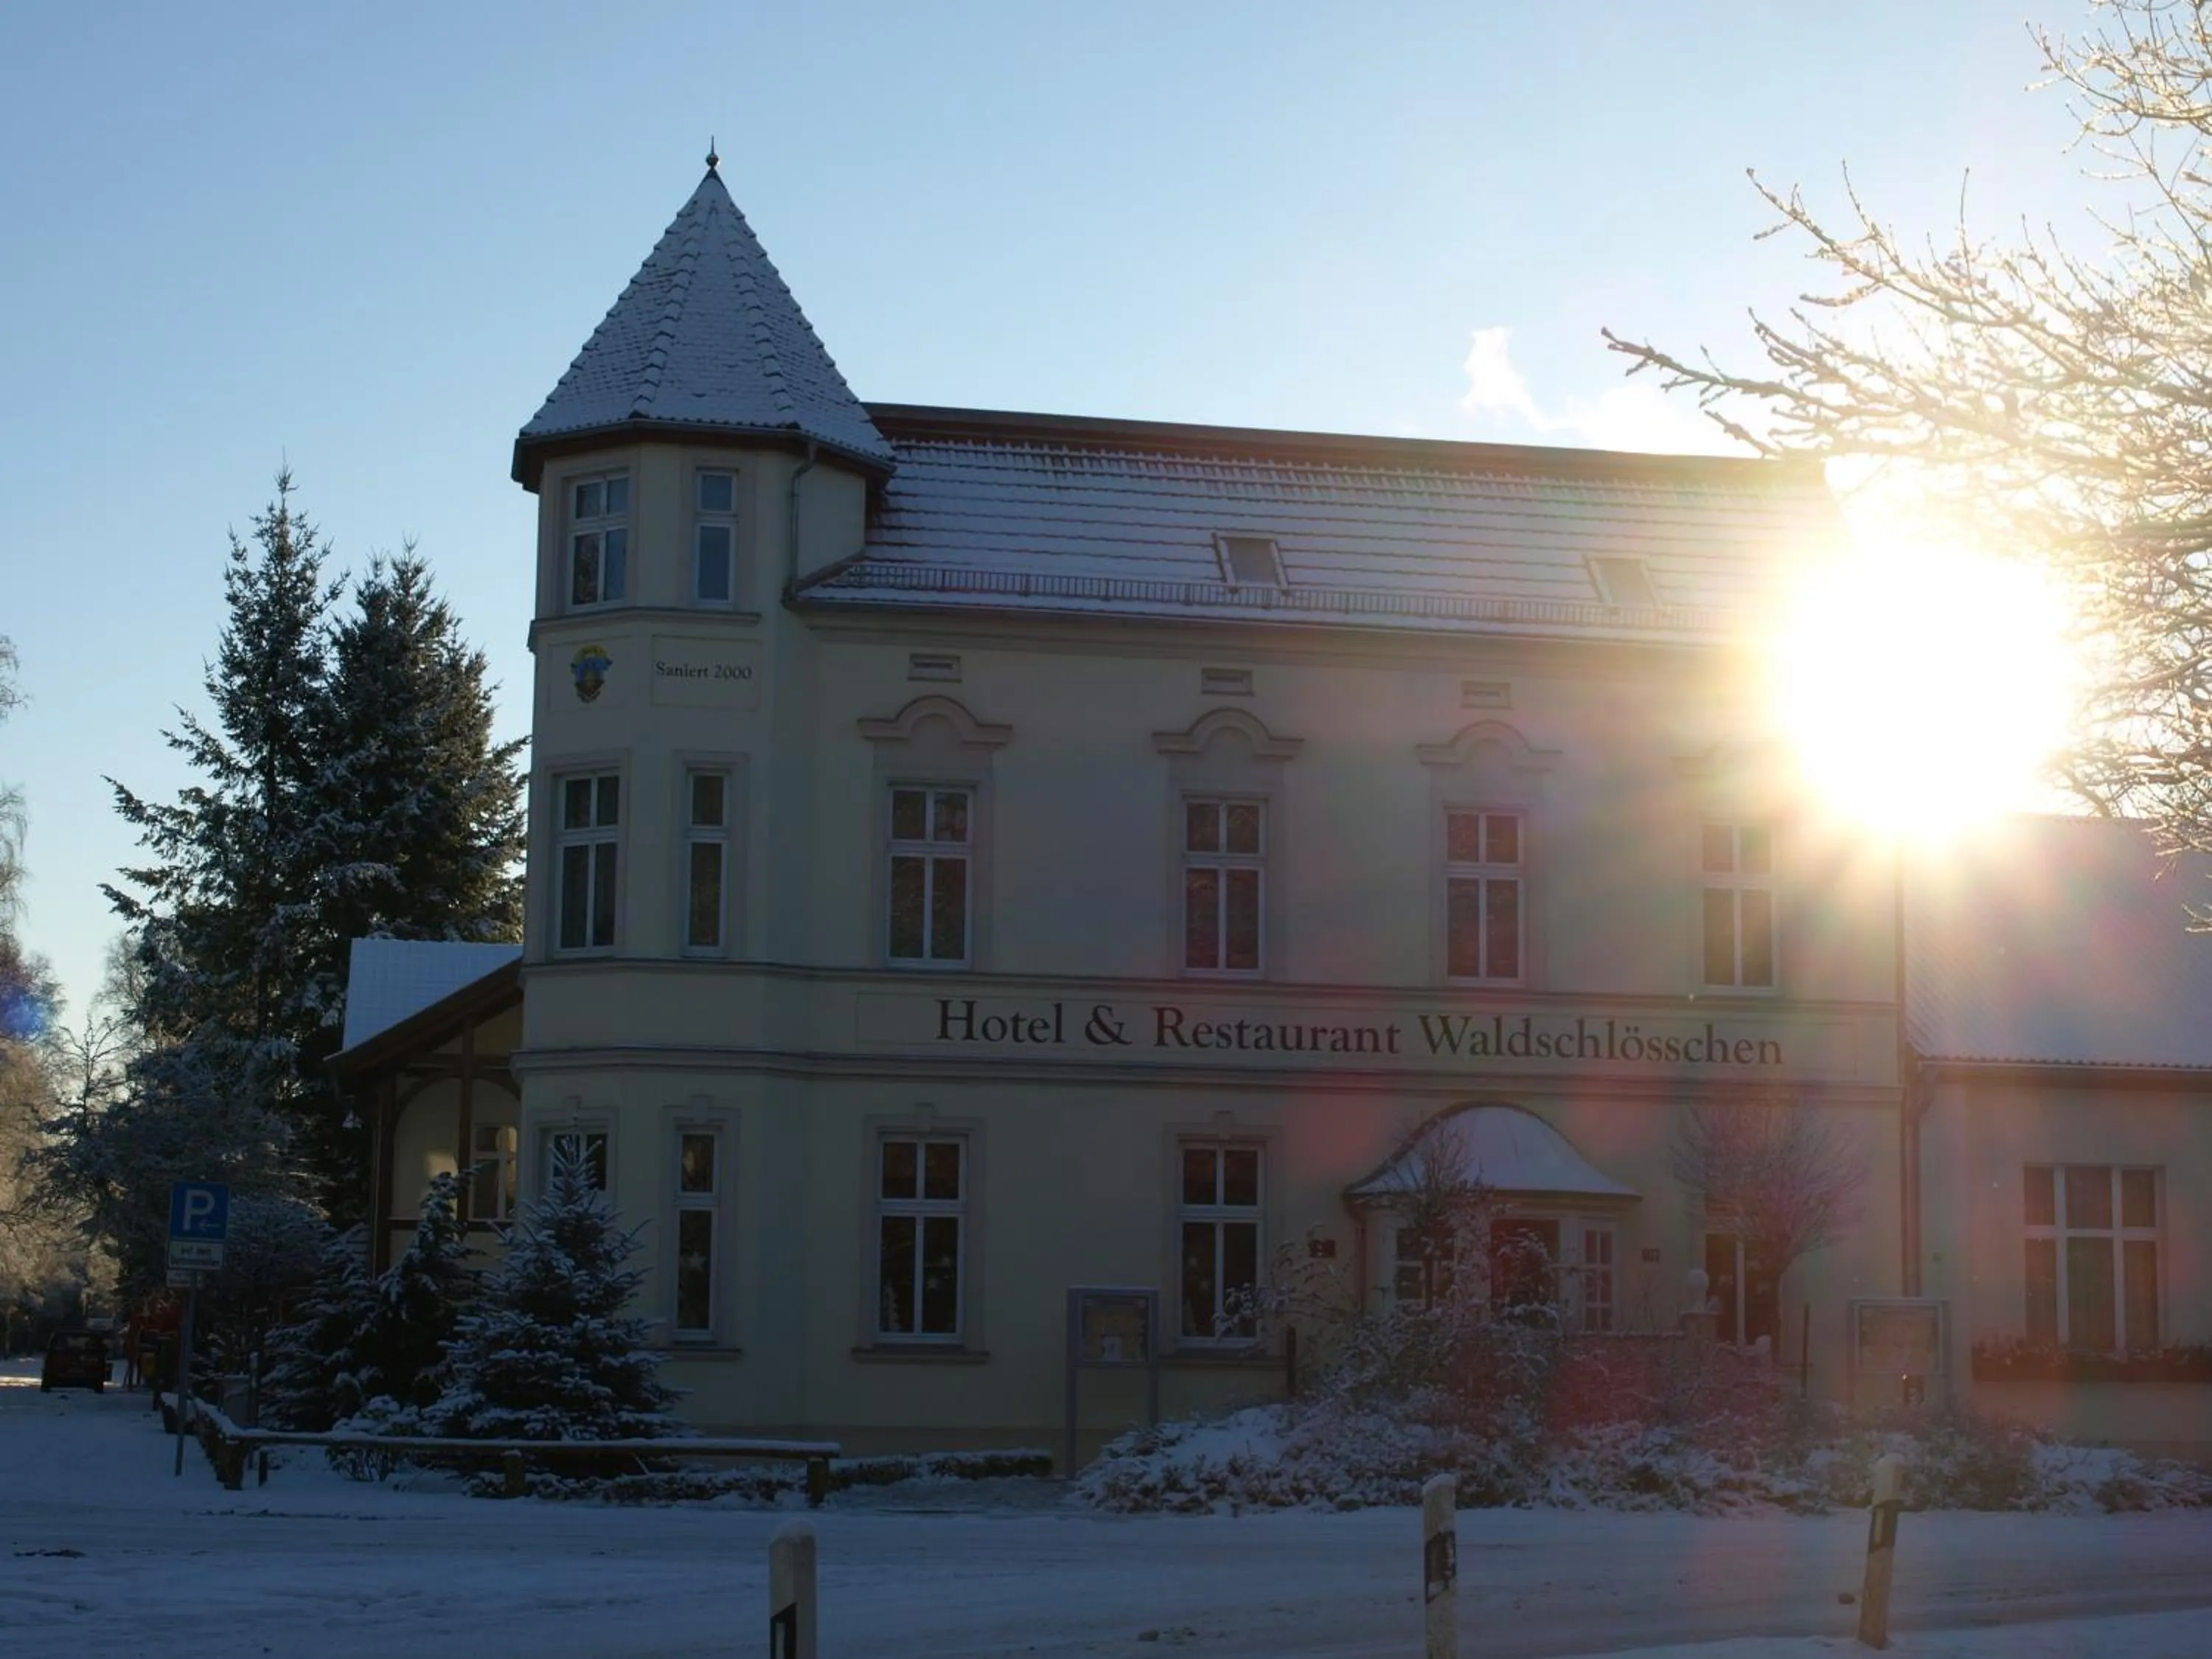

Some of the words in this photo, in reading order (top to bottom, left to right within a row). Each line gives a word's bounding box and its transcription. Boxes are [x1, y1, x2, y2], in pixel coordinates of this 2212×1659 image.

[656, 661, 709, 678] Saniert
[714, 664, 752, 679] 2000
[936, 999, 1066, 1043] Hotel
[1085, 1004, 1133, 1046] &
[1152, 1006, 1400, 1054] Restaurant
[1418, 1015, 1783, 1064] Waldschlösschen
[183, 1189, 215, 1231] P
